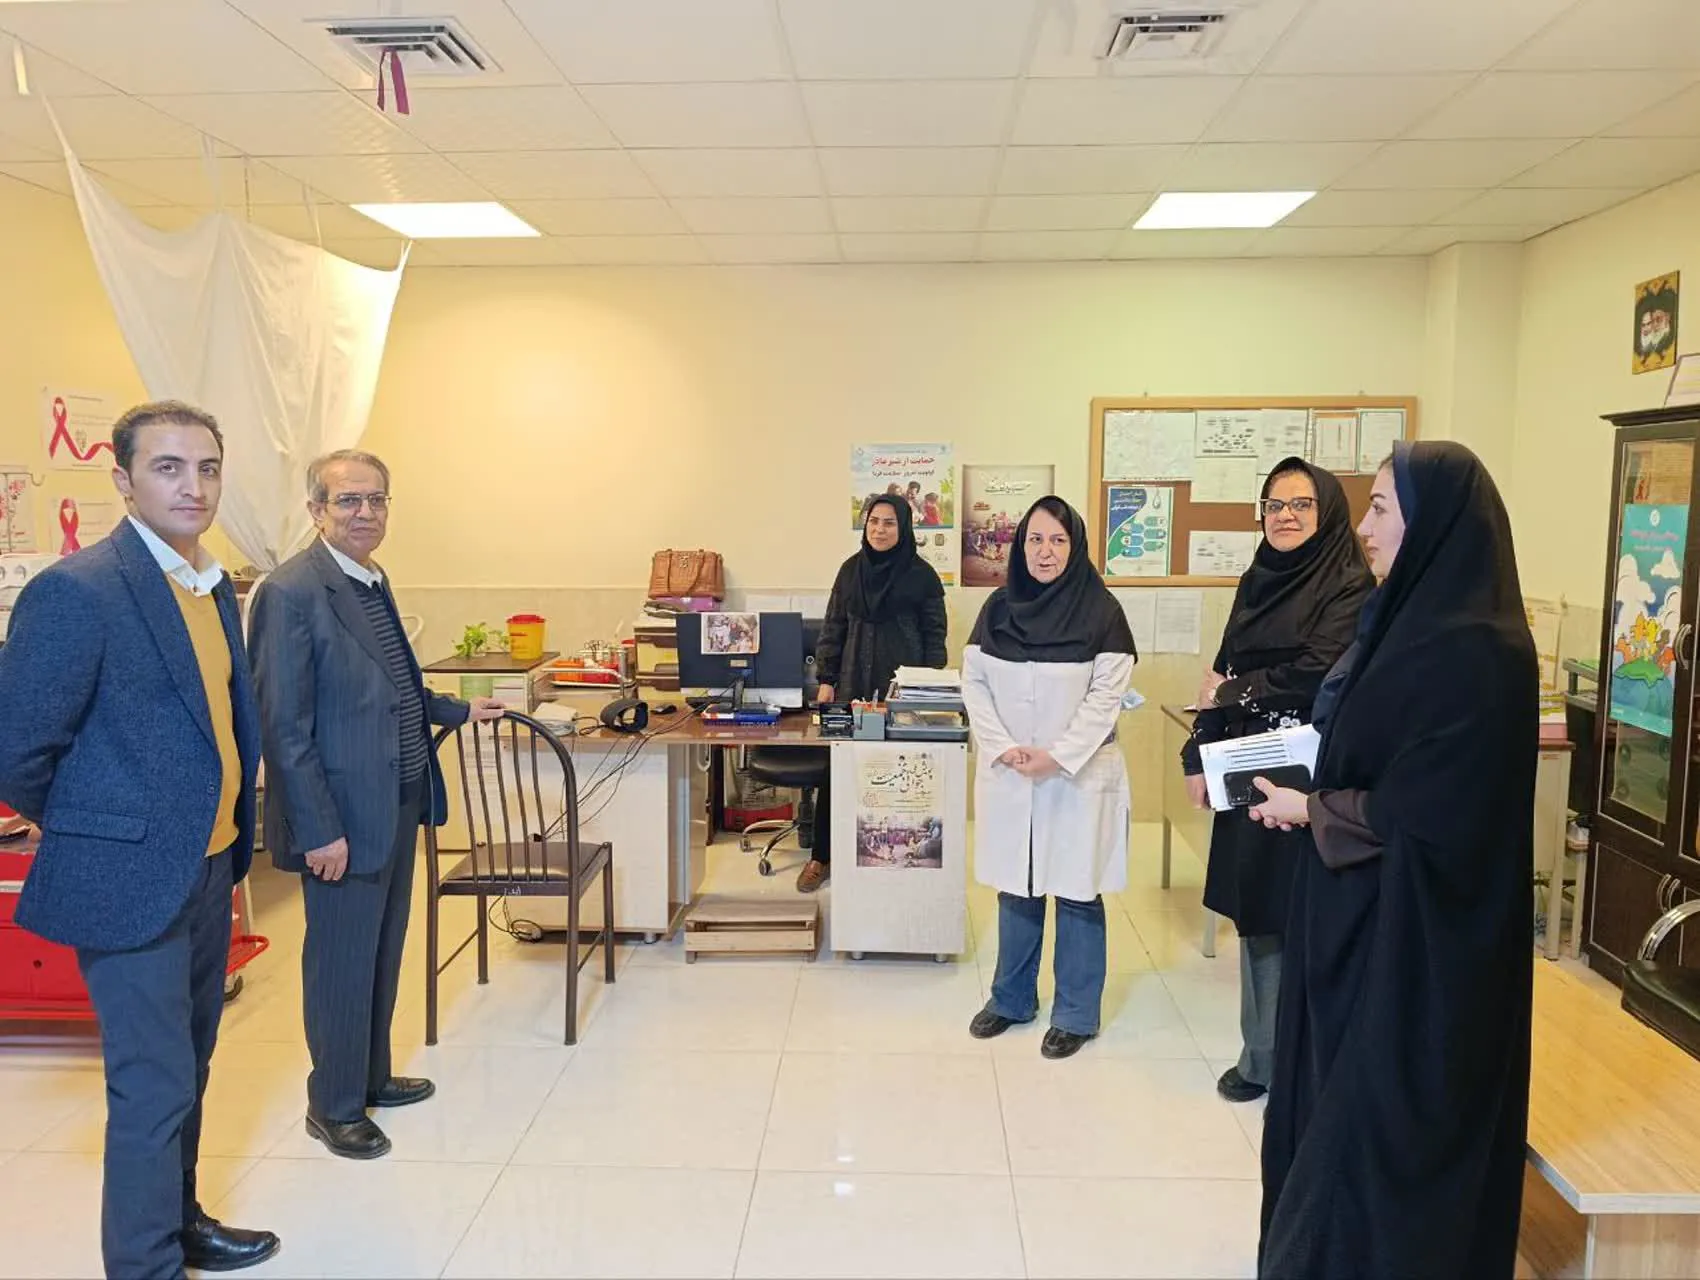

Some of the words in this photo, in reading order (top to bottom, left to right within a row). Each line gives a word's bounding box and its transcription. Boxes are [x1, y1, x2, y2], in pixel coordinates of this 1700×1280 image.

[871, 456, 887, 467] مادر
[887, 457, 902, 467] شیر
[901, 457, 910, 467] از
[910, 456, 935, 465] حمایت
